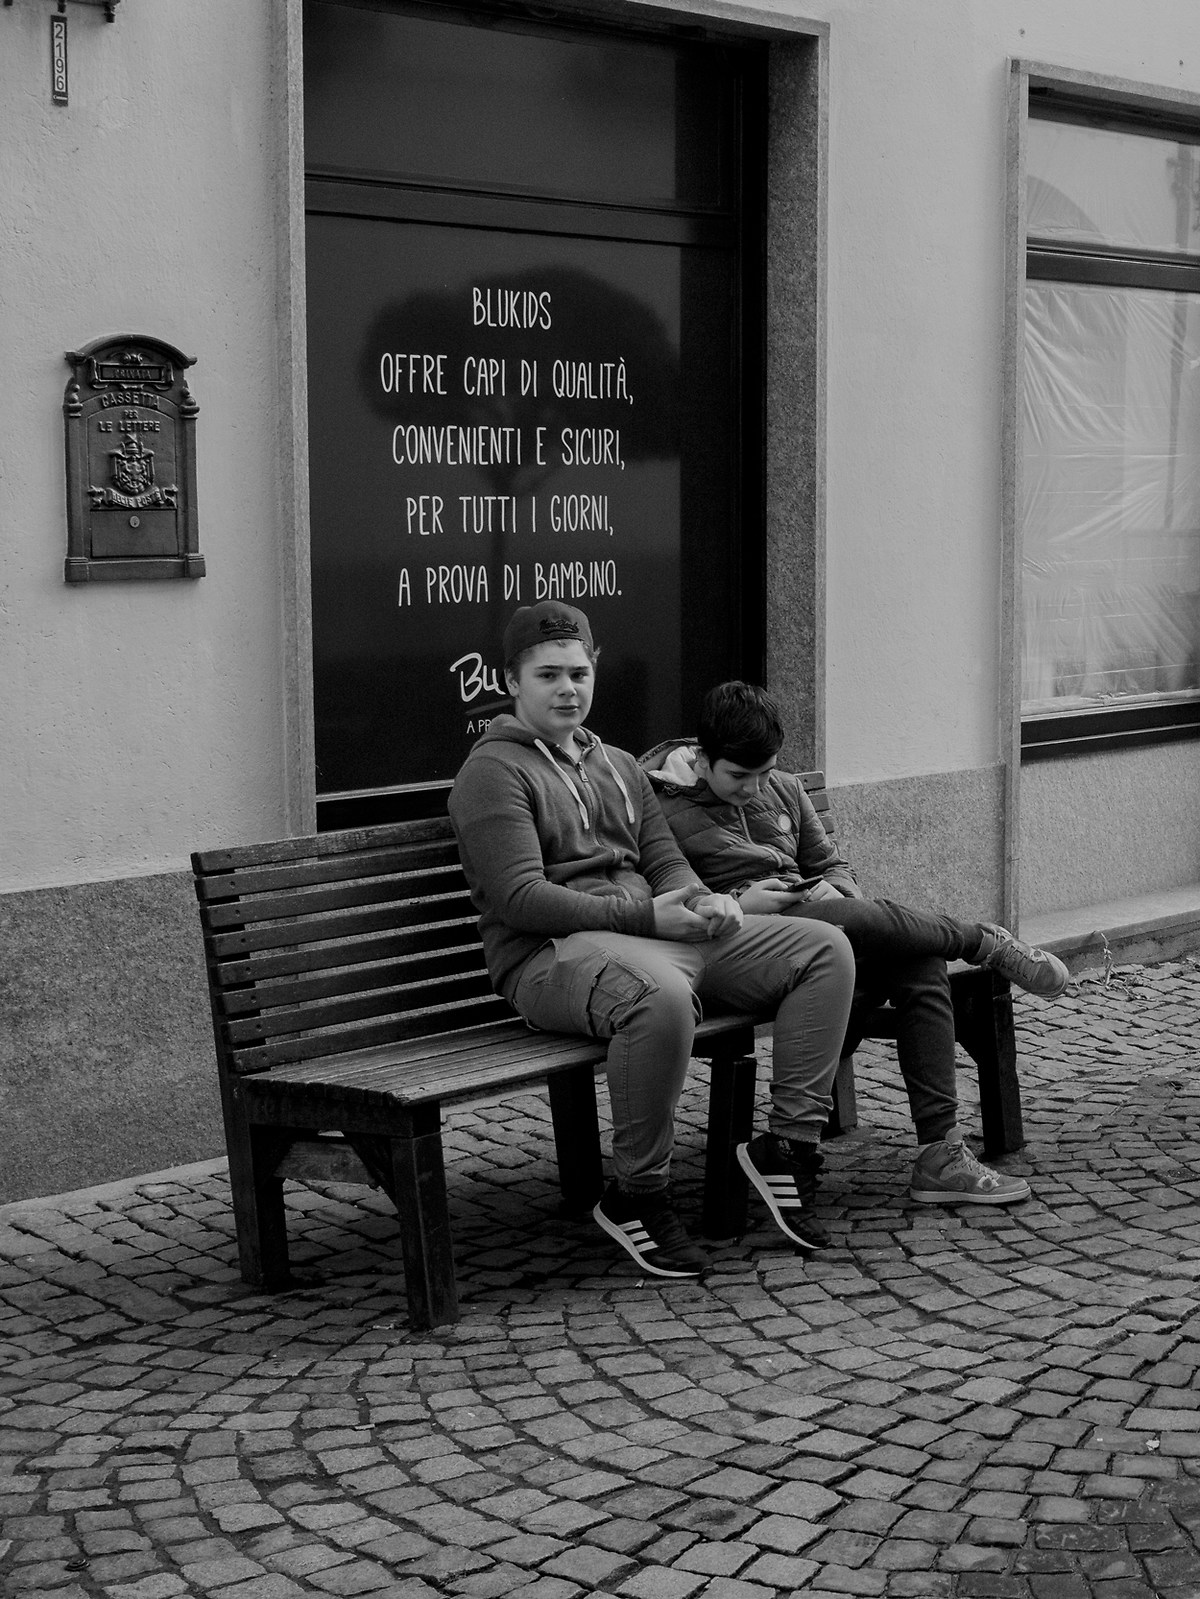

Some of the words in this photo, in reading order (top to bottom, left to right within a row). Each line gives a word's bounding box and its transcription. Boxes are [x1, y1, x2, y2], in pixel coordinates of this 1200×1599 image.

[54, 23, 65, 91] 2196
[472, 287, 551, 330] BLUKIDS
[101, 391, 160, 409] CASSETTA
[380, 352, 448, 395] OFFRE
[463, 356, 506, 397] CAPI
[520, 359, 537, 398] DI
[552, 356, 634, 405] QUALITÀ,
[98, 420, 113, 432] LE
[119, 420, 160, 432] LETTERE
[392, 424, 521, 466] CONVENIENTI
[536, 426, 547, 466] E
[561, 427, 625, 471] SICURI,
[406, 495, 444, 536] PER
[458, 495, 517, 534] TUTTI
[532, 496, 536, 533] I
[550, 494, 614, 536] GIORNI,
[398, 567, 411, 607] A
[426, 564, 489, 604] PROVA
[503, 564, 521, 601] DI
[534, 559, 622, 600] BAMBINO.
[466, 720, 476, 734] A
